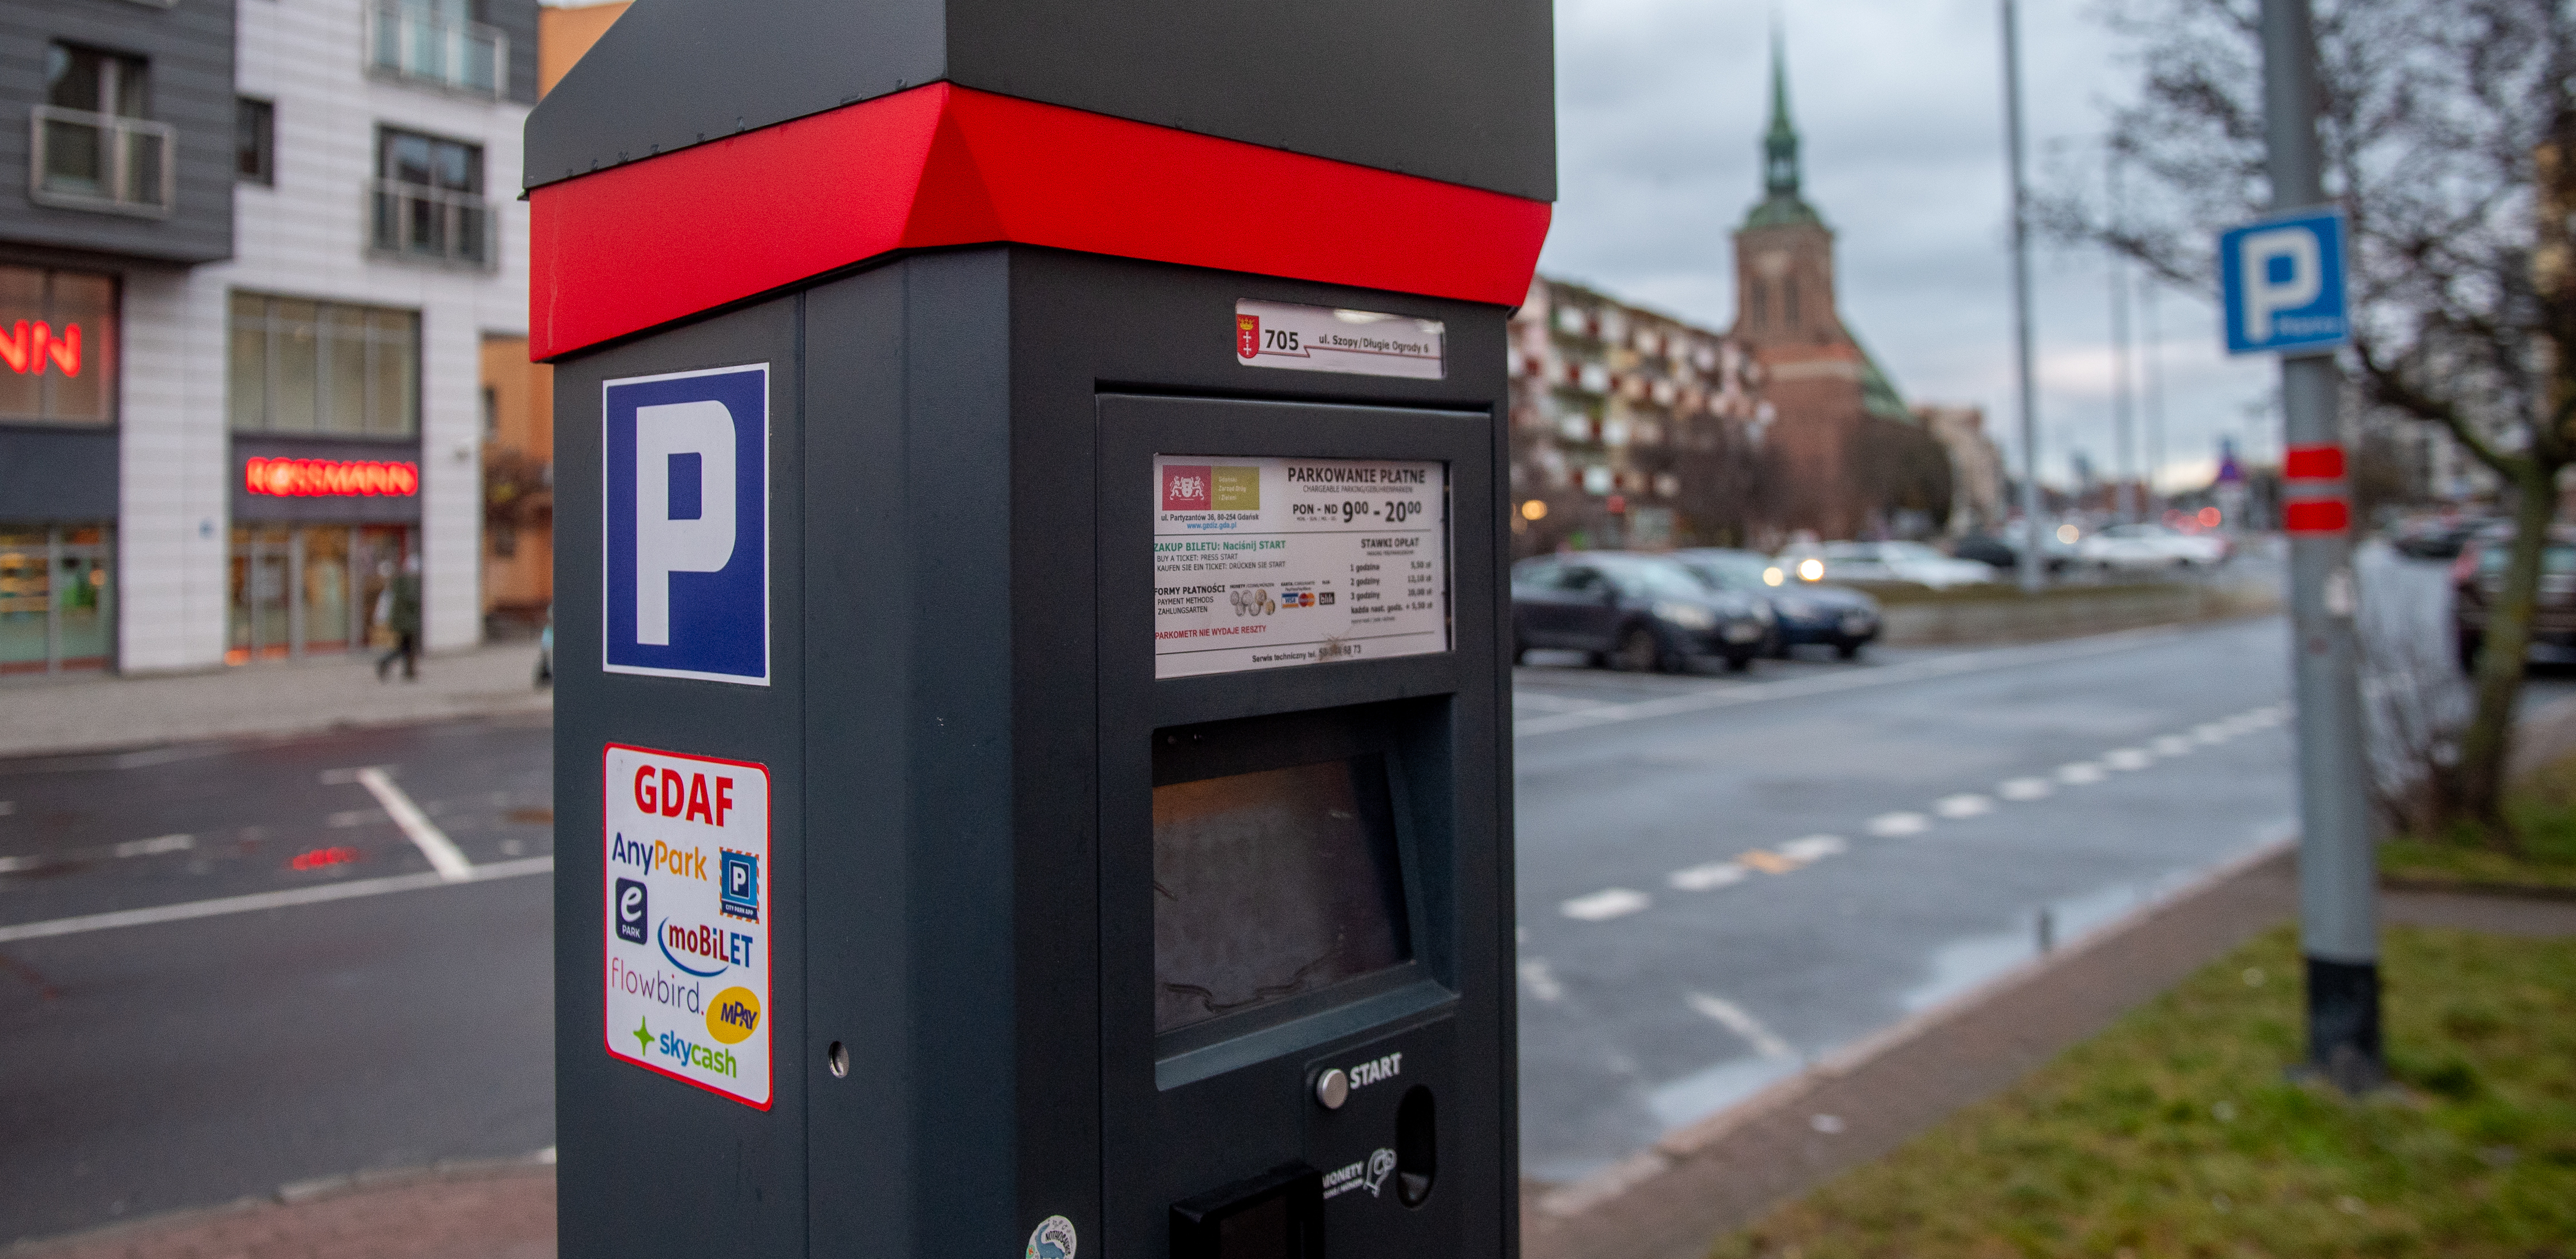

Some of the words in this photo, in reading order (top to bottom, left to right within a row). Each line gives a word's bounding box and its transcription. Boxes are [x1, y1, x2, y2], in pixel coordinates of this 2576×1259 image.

[2241, 227, 2324, 342] P
[1265, 329, 1299, 350] 705
[1319, 335, 1329, 345] ul.
[1333, 336, 1390, 350] Szopy/Długie
[1392, 341, 1421, 354] Ogrody
[246, 456, 418, 497] ROSSMANN
[1288, 467, 1376, 483] PARKOWANIE
[1380, 469, 1425, 484] PŁATNE
[1303, 485, 1339, 493] CHARGEABLE
[1293, 503, 1314, 515] PON
[1324, 504, 1338, 515] ND
[637, 400, 736, 645] P
[1170, 514, 1206, 522] Partyzantów
[1207, 514, 1215, 522] 36,
[1238, 512, 1259, 520] Gdańsk
[1187, 522, 1236, 530] www.gzdiz.gda.pl
[1154, 543, 1183, 551] ZAKUP
[1186, 542, 1220, 551] BILETU:
[1223, 540, 1256, 551] Naciśnij
[1259, 540, 1286, 550] START
[1361, 538, 1392, 548] STAWKI
[1394, 537, 1419, 547] OPŁAT
[1229, 561, 1256, 569] DRÜCKEN
[1350, 563, 1354, 571] 1
[1356, 564, 1380, 573] godzina
[1350, 578, 1354, 586] 2
[1356, 577, 1380, 587] godziny
[1155, 587, 1180, 596] FORMY
[1183, 583, 1225, 594] PŁATNOŚCI
[1350, 592, 1354, 600] 3
[1356, 591, 1380, 601] godziny
[1157, 598, 1184, 606] PAYMENT
[1186, 597, 1214, 605] METHODS
[1158, 606, 1207, 615] ZAHLUNGSARTEN
[1155, 629, 1197, 640] PARKOMETR
[1199, 628, 1210, 637] NIE
[1212, 626, 1239, 636] WYDAJE
[1241, 625, 1266, 634] RESZTY
[1252, 654, 1272, 662] Serwis
[1274, 652, 1306, 660] techniczny
[634, 764, 733, 827] GDAF
[612, 832, 707, 881] AnyPark
[733, 866, 746, 891] P
[621, 887, 642, 922] e
[622, 925, 641, 938] PARK
[659, 1029, 737, 1079] skycash
[1350, 1051, 1402, 1090] START
